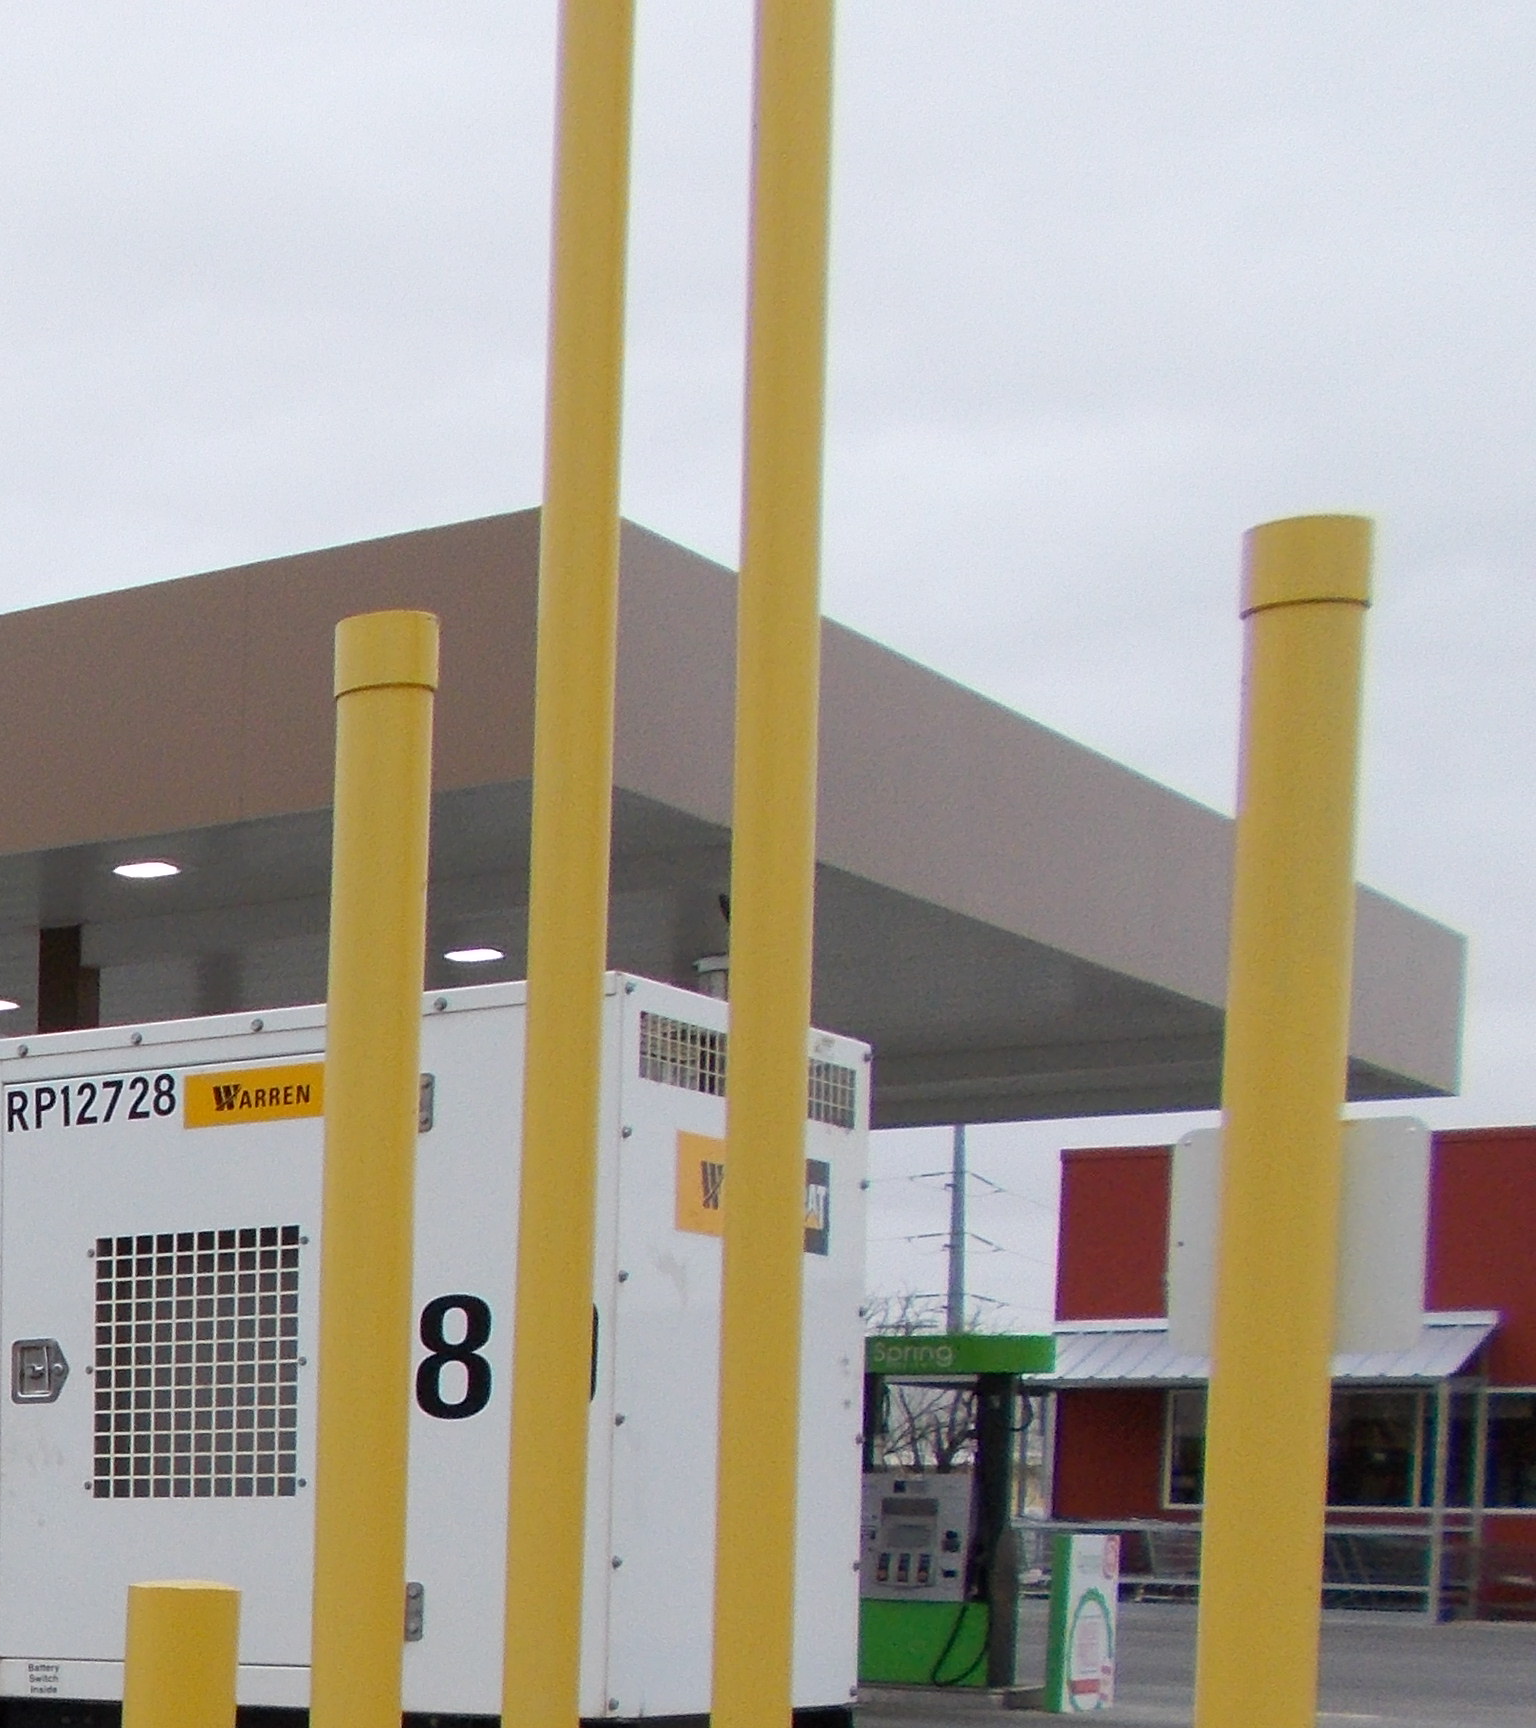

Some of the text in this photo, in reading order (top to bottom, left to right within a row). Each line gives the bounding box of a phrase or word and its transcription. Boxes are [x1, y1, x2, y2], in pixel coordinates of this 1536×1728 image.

[7, 1073, 176, 1132] RP12728
[212, 1083, 312, 1112] WARREN
[873, 1342, 954, 1368] Spring
[28, 1663, 60, 1672] Battery
[29, 1674, 59, 1683] Switch
[30, 1685, 58, 1694] Inside
